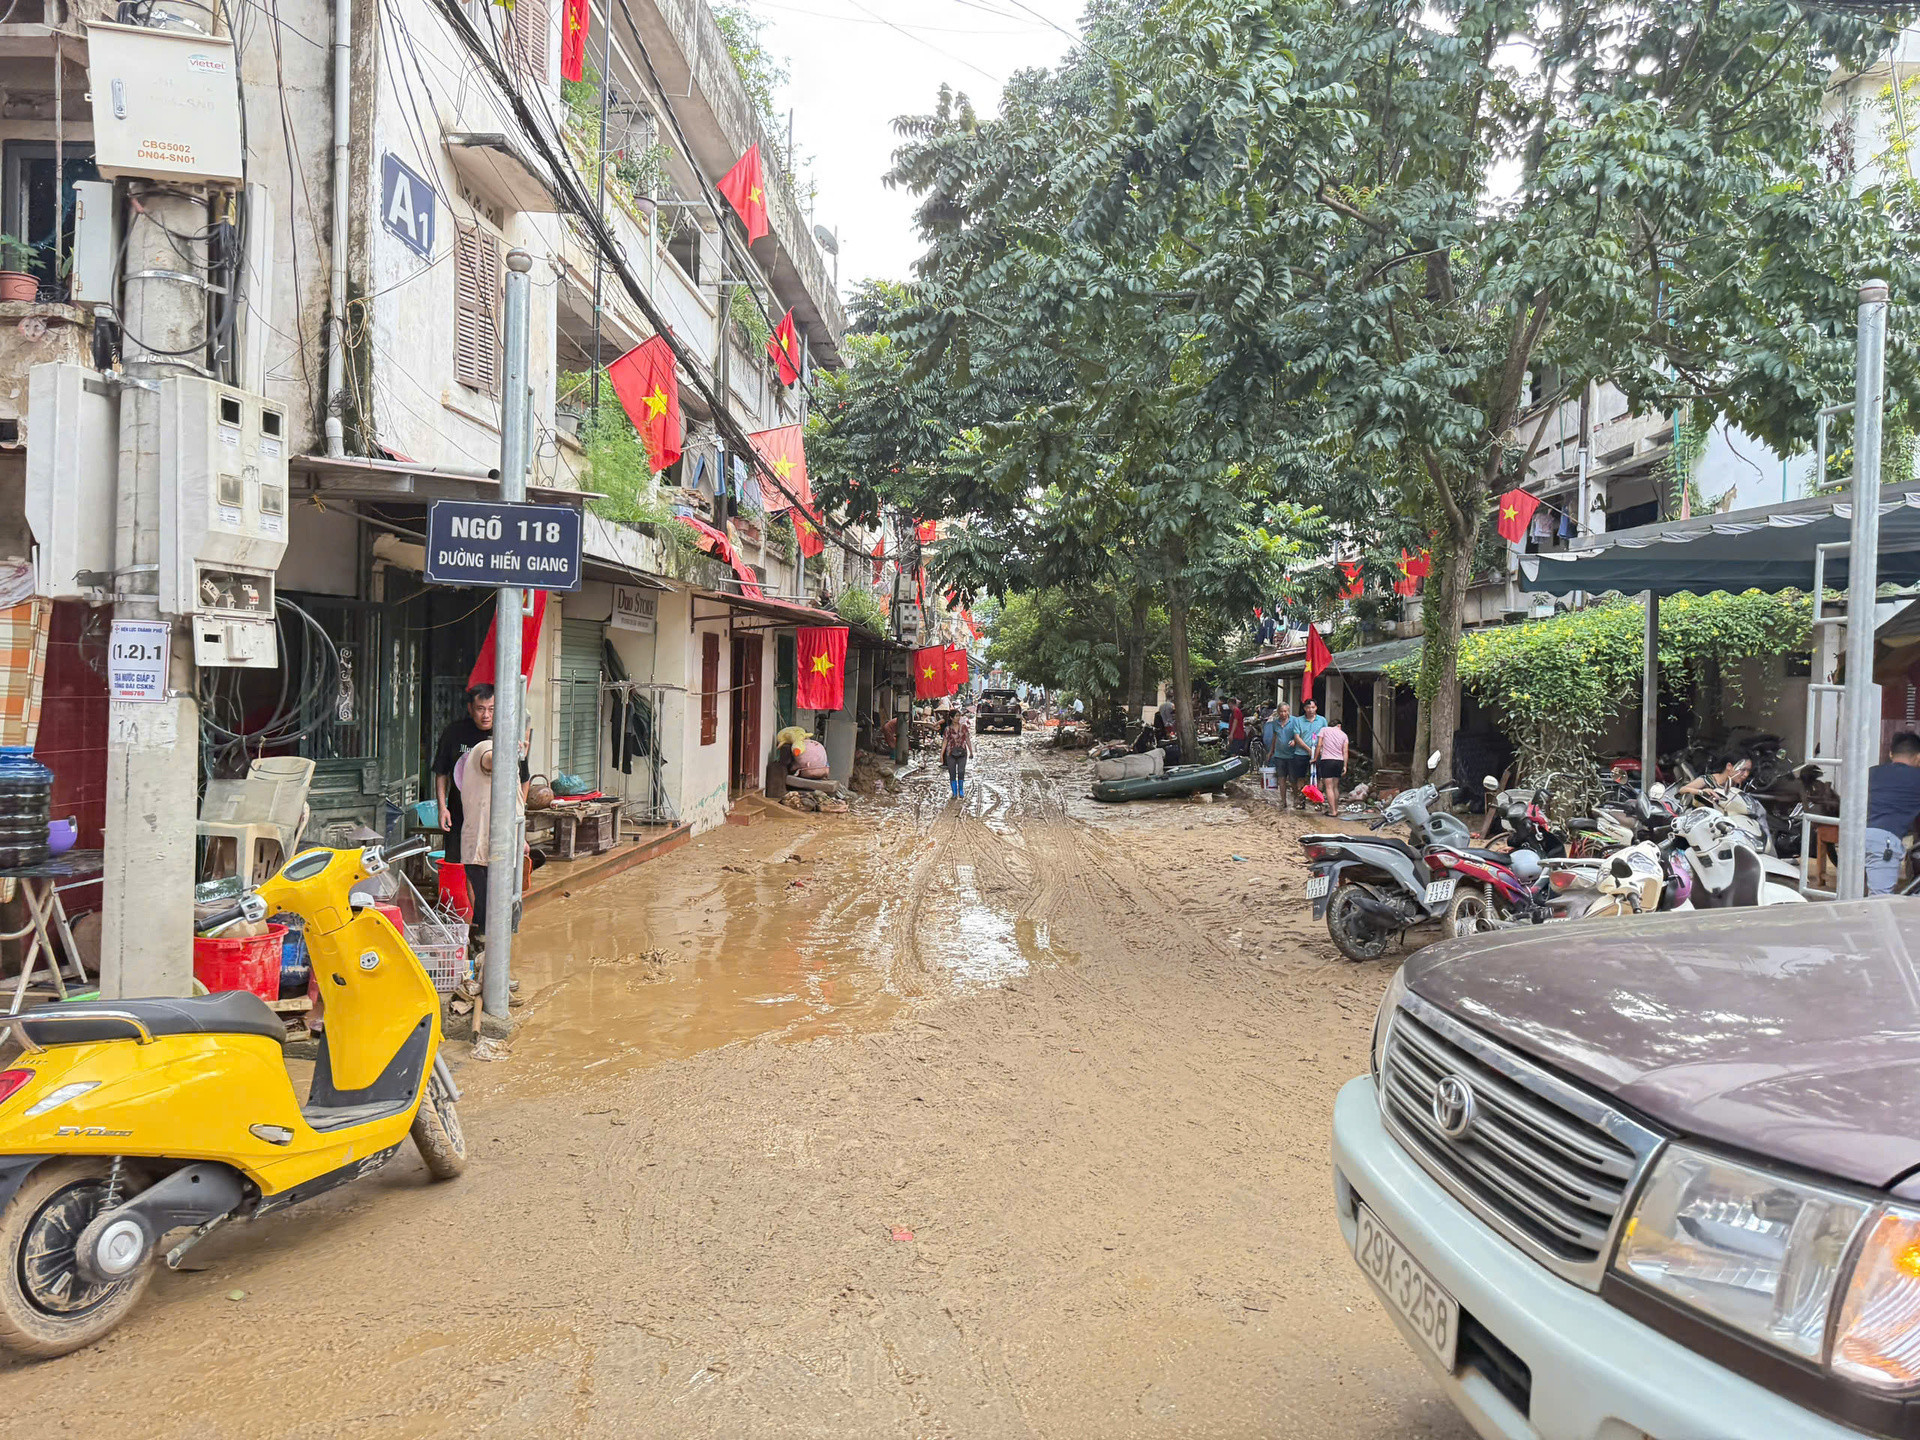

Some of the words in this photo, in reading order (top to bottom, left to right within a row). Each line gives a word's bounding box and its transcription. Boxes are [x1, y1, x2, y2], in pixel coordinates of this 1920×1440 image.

[190, 59, 224, 70] viettel
[142, 140, 191, 153] CBG5002
[137, 150, 196, 164] DN04-SN01
[451, 515, 502, 540] NGÕ
[517, 520, 561, 543] 118
[438, 548, 484, 568] ĐƯỜNG
[490, 550, 521, 570] HIẾN
[527, 556, 569, 573] GIANG
[112, 643, 162, 660] (1.2).1
[151, 674, 156, 682] 3
[1428, 890, 1449, 901] 2323
